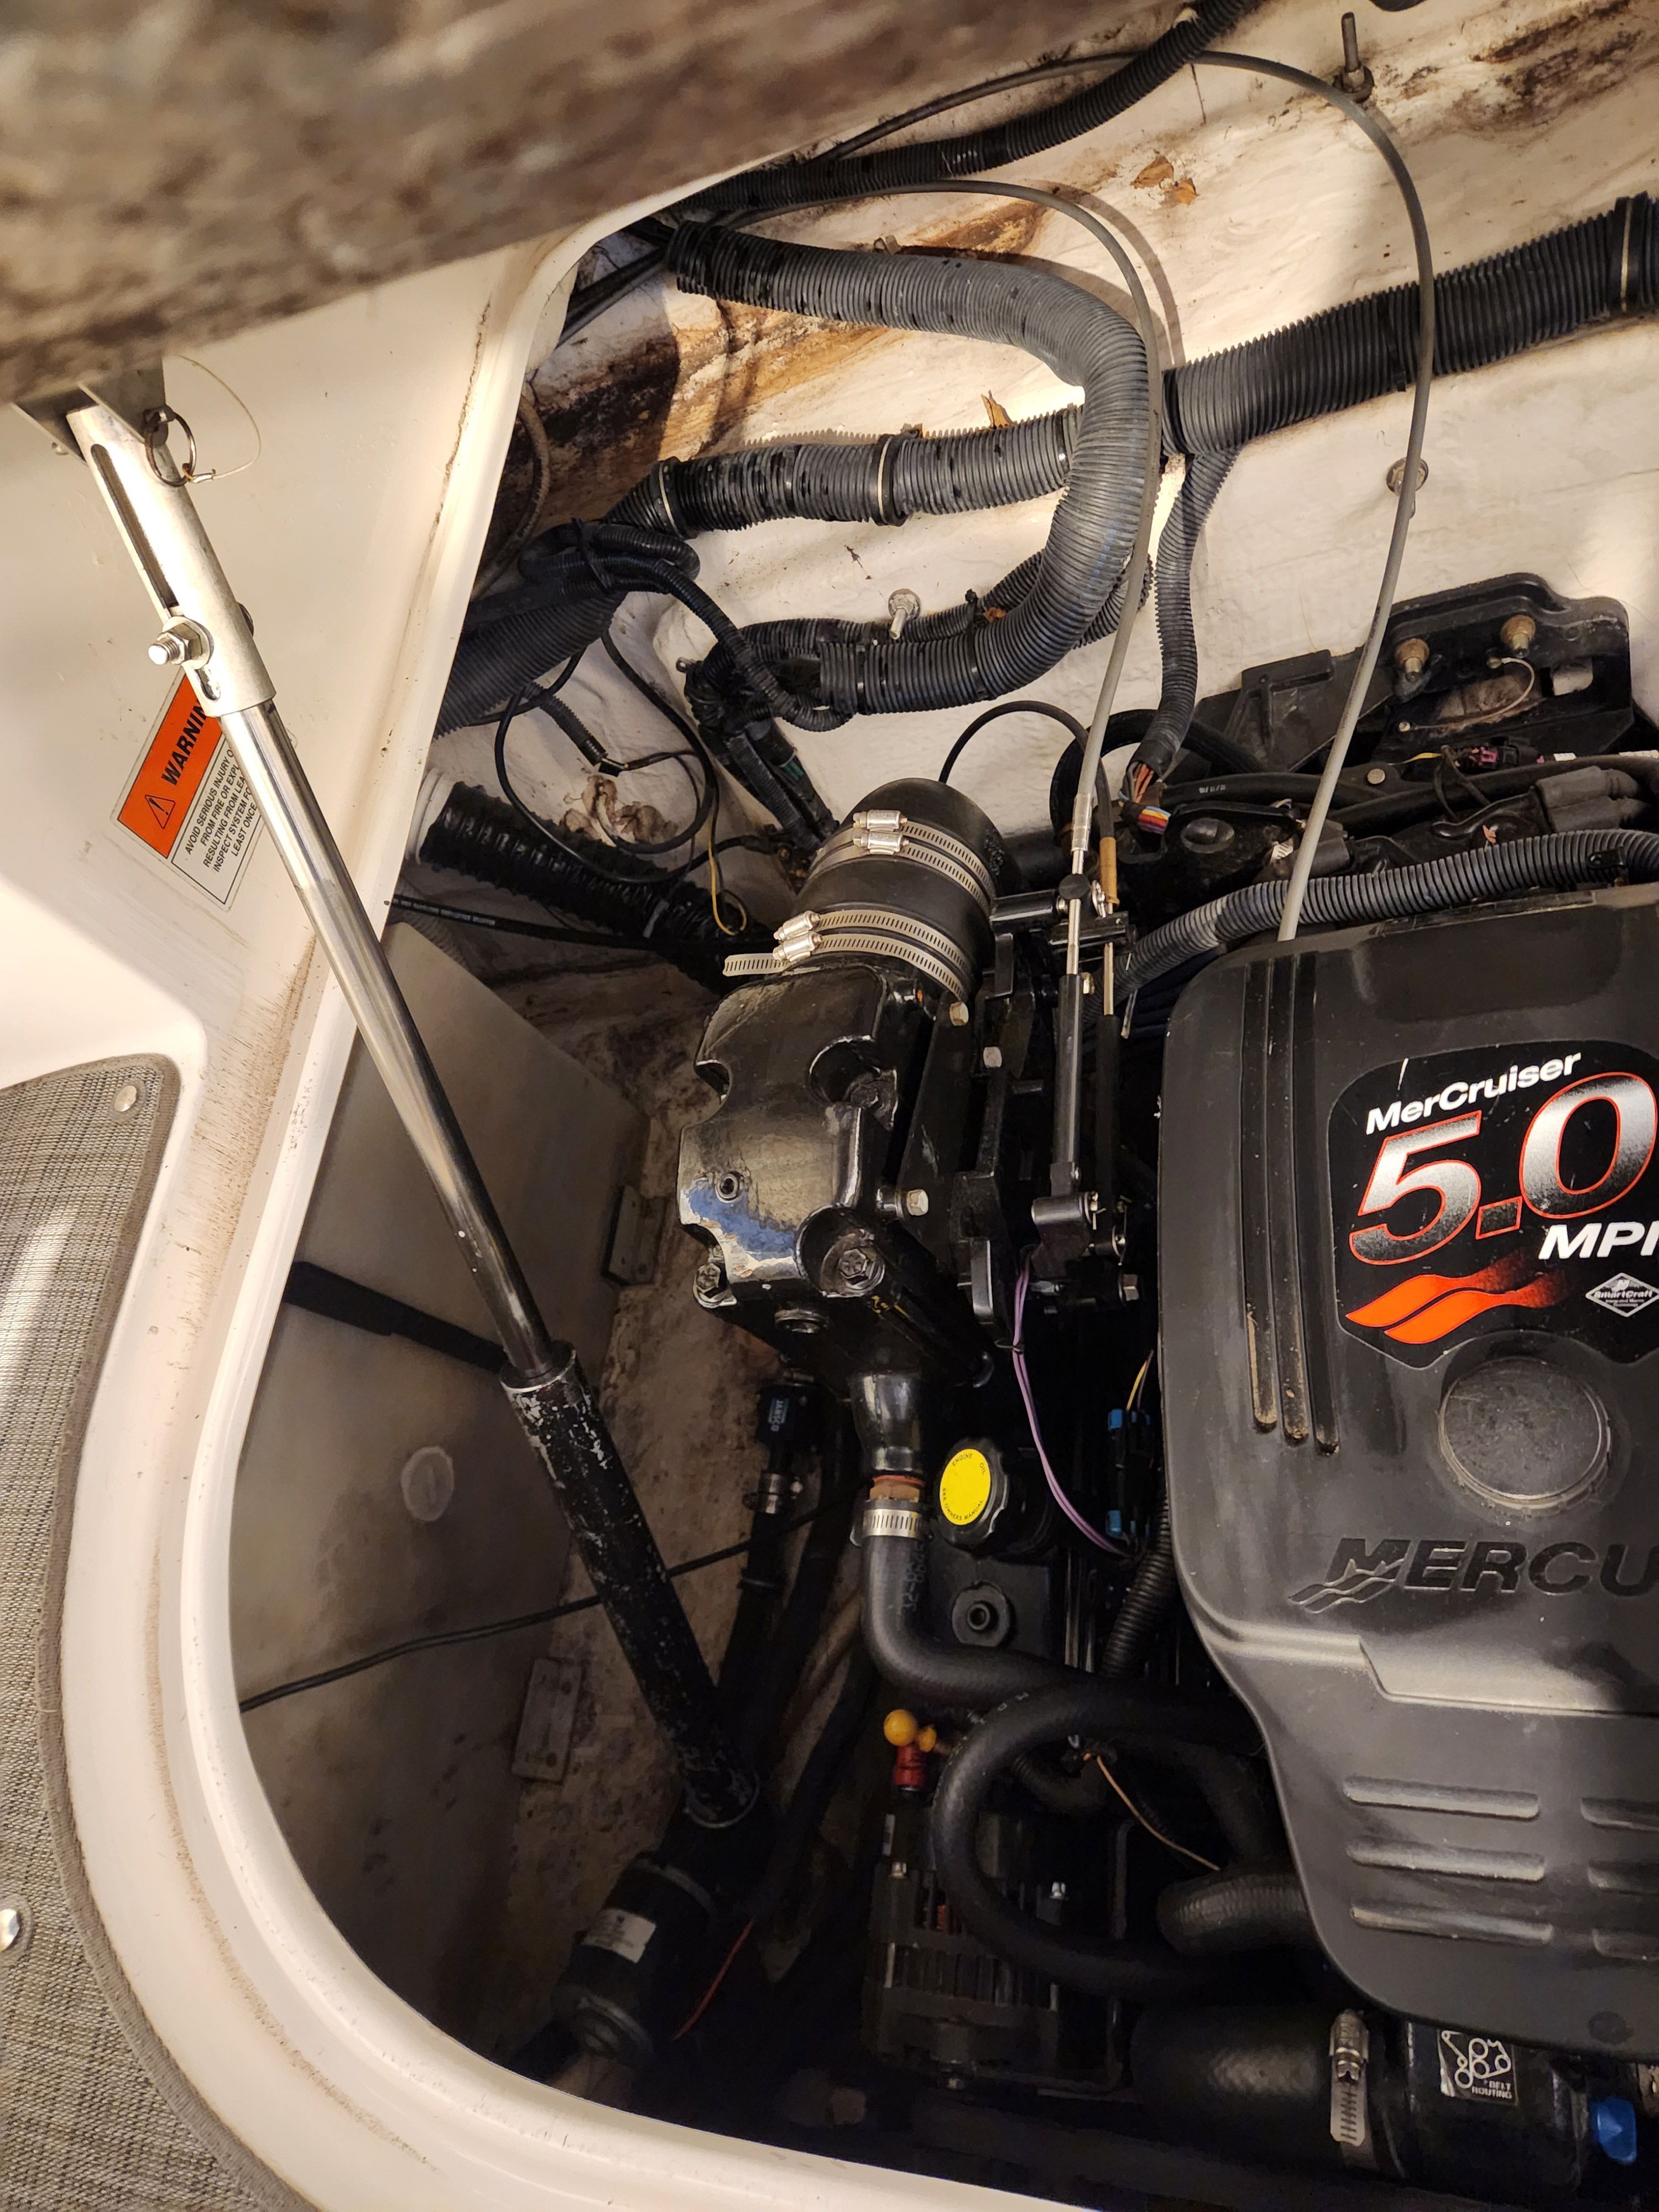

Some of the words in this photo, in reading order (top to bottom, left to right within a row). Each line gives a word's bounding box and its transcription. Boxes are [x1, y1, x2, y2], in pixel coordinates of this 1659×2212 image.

[185, 826, 201, 854] AVOID
[196, 787, 217, 827] SERIOUS
[213, 756, 230, 789] INJURY
[200, 817, 216, 847] FROM
[212, 798, 225, 820] FIRE
[221, 786, 231, 799] OR
[203, 818, 228, 868] RESULTING
[223, 794, 239, 820] FROM
[231, 828, 247, 857] LEAST
[243, 802, 257, 827] ONCE
[213, 833, 233, 873] INSPECT
[229, 799, 248, 835] SYSTEM
[1365, 1052, 1582, 1135] MerCruiser
[1349, 1071, 1658, 1265] 5.0
[1538, 1220, 1659, 1260] MPI
[952, 1453, 973, 1467] ENGINE
[945, 1503, 962, 1521] OWNERS
[964, 1500, 983, 1520] MANUAL
[1472, 2086, 1512, 2099] ROUTING
